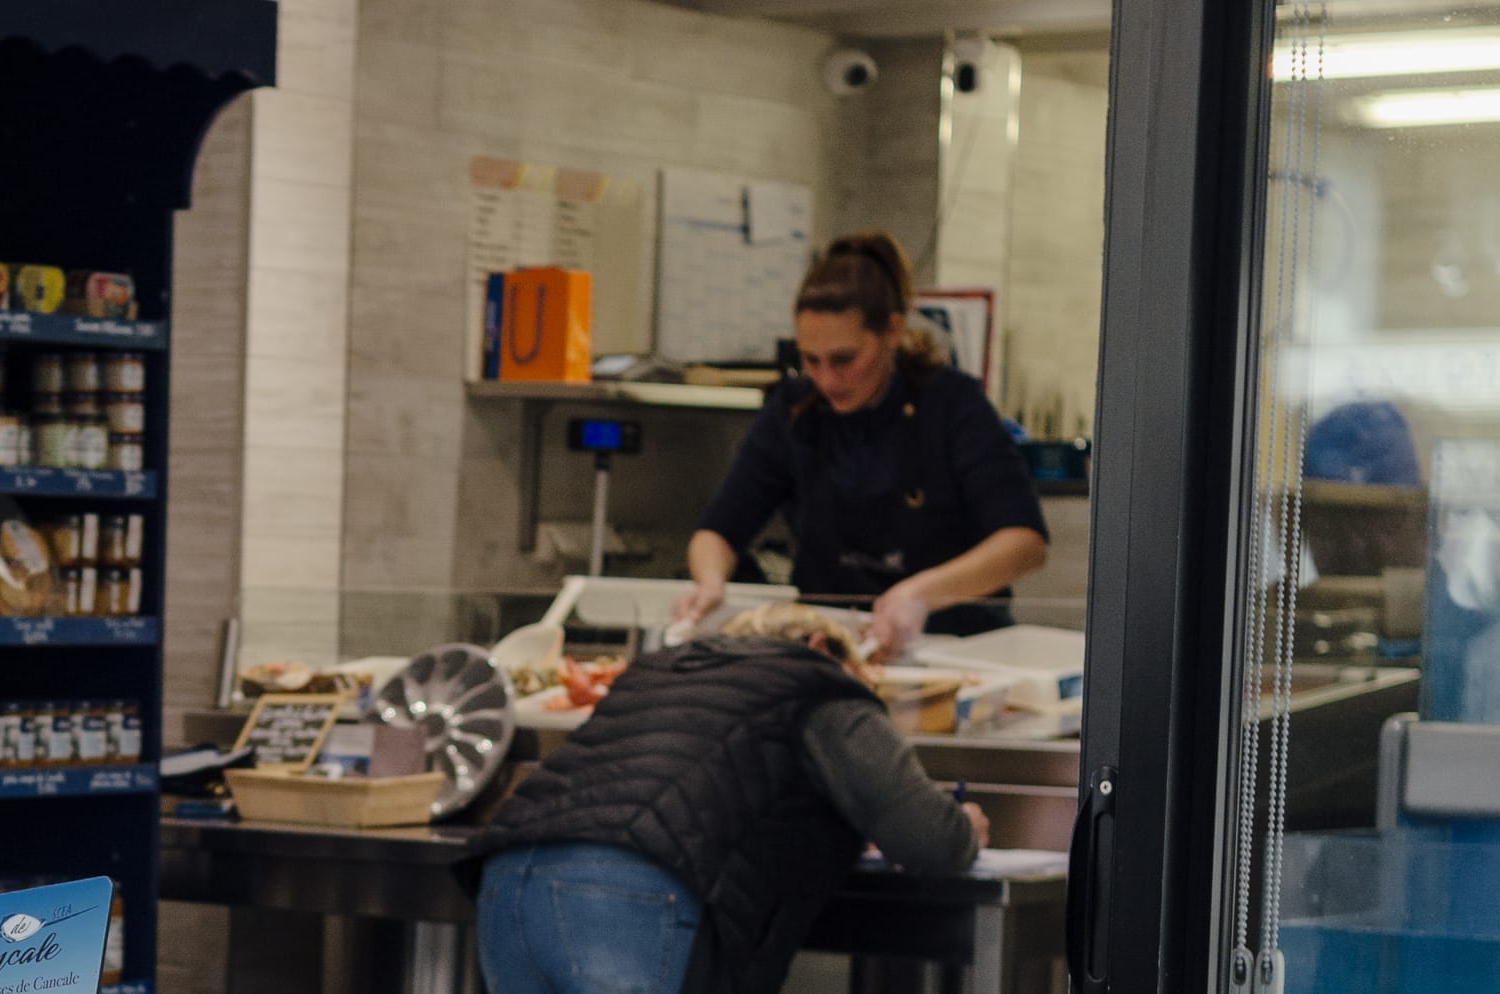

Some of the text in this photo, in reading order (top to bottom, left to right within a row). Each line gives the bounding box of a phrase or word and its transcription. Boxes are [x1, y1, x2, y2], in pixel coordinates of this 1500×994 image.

[10, 917, 29, 934] de
[15, 980, 31, 994] de
[33, 971, 80, 991] Cancale
